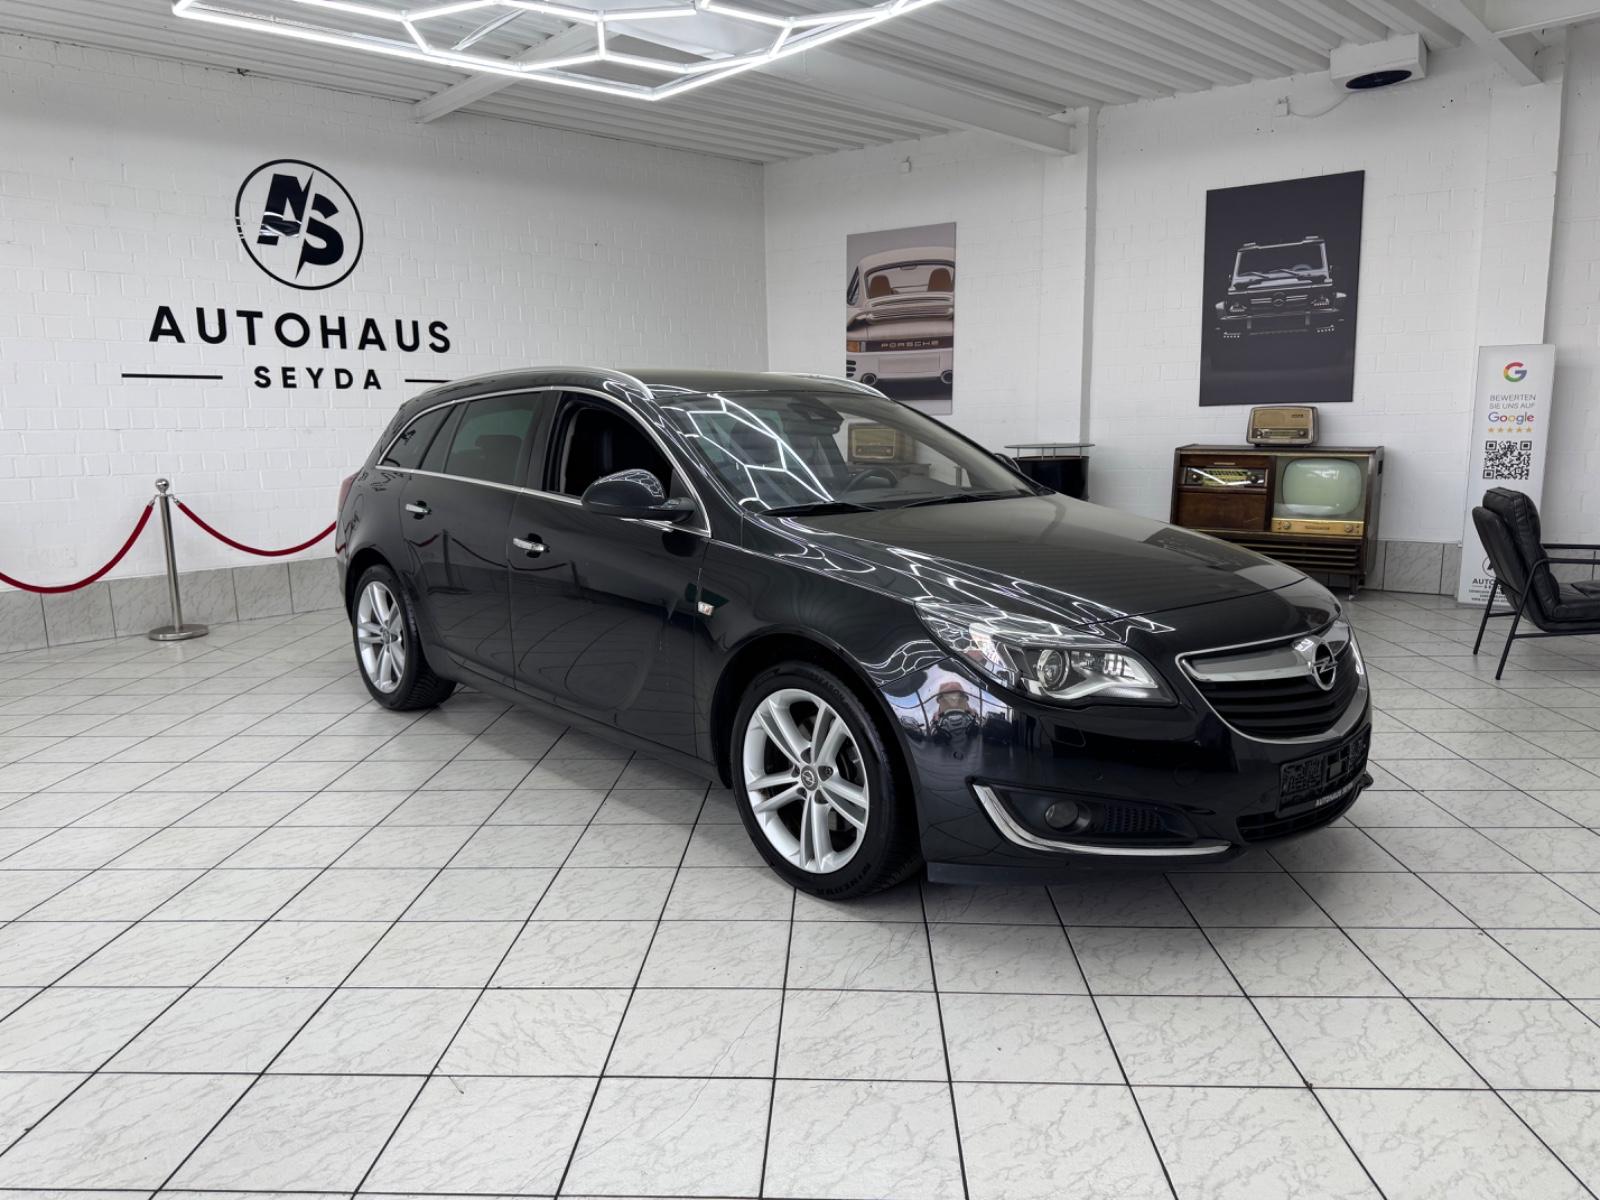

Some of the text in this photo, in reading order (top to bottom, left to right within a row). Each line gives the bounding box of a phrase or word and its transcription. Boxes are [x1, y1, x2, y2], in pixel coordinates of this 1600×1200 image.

[149, 305, 451, 353] AUTOHAUS
[881, 341, 938, 349] PORSCHE
[254, 366, 382, 390] SEYDA
[1503, 361, 1527, 383] G
[1488, 411, 1535, 425] Google
